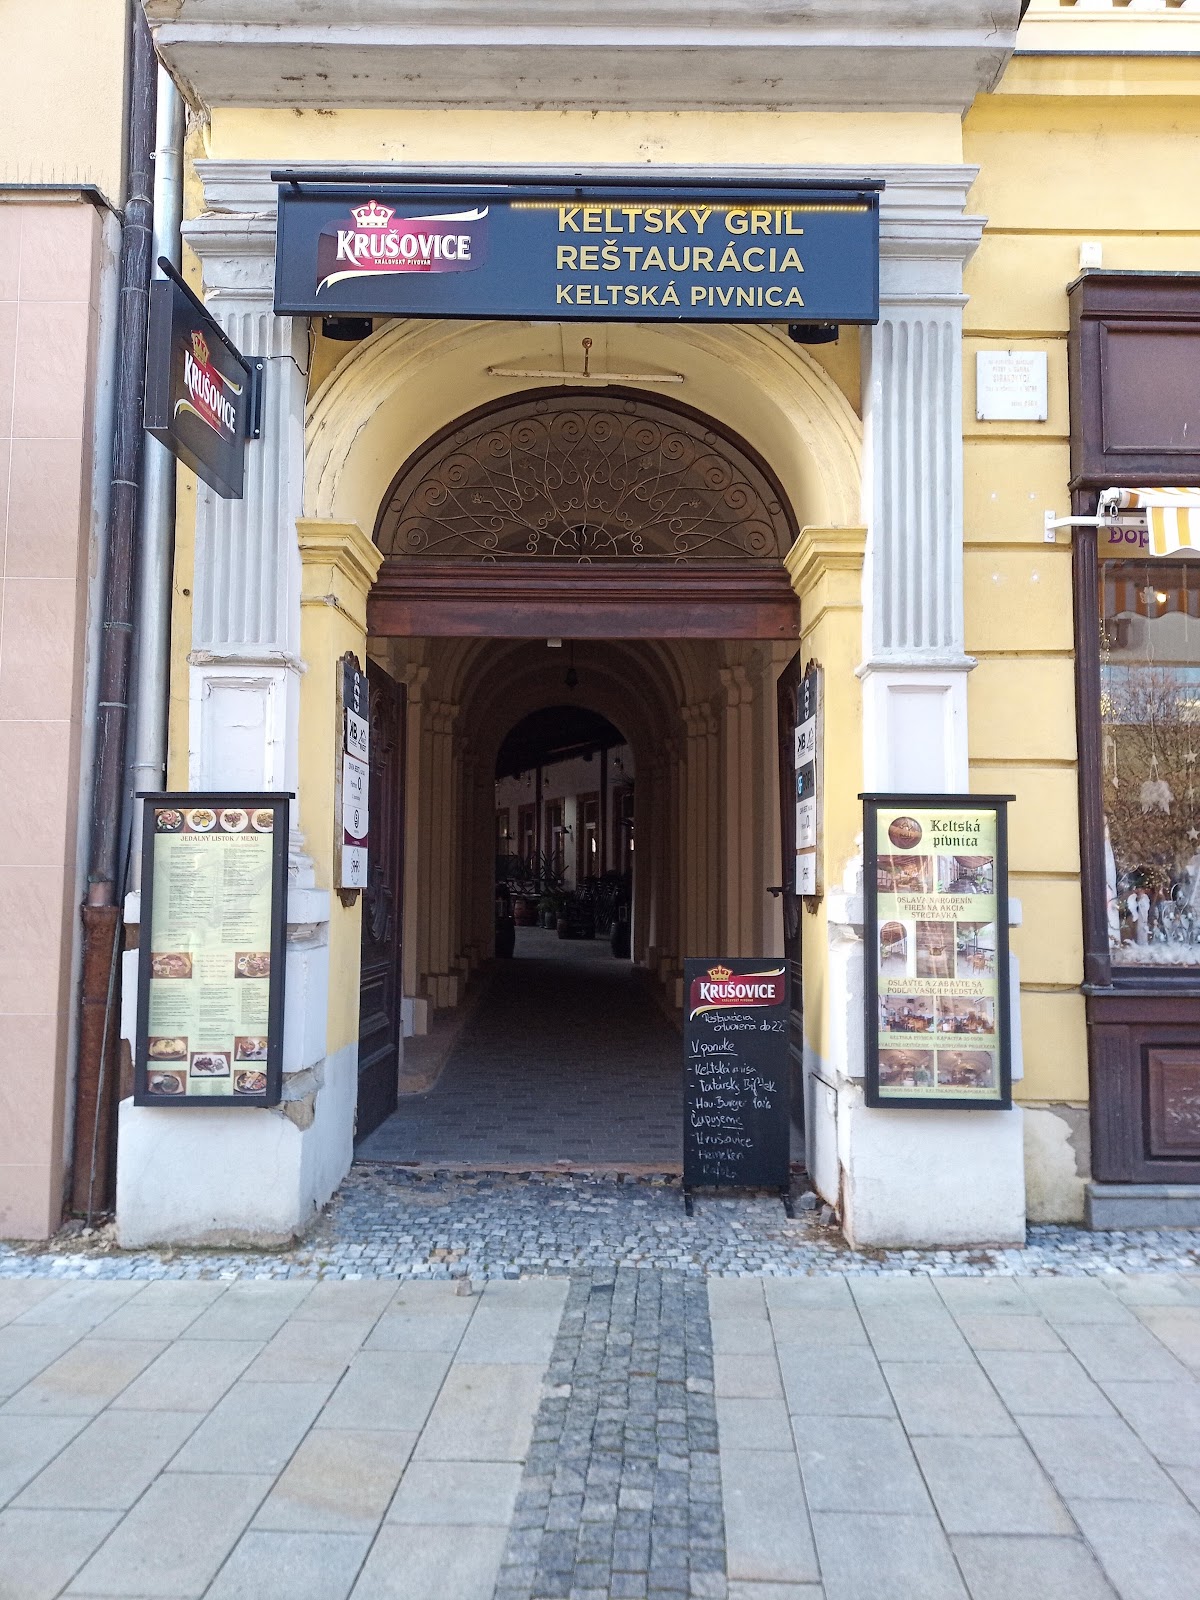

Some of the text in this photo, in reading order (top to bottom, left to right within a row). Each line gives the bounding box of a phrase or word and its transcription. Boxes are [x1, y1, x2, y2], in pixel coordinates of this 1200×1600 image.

[558, 204, 804, 235] KELTSKÝ GRIL
[335, 229, 472, 267] KRUŠOVICE
[556, 239, 805, 272] REŠTAURÁCIA
[556, 280, 805, 307] KELTSKÁ PIVNICA
[184, 350, 236, 434] KRUŠOVICE
[930, 818, 981, 832] Keltská
[933, 834, 978, 848] pivnica
[699, 981, 776, 1004] KRUŠOVICE
[759, 1019, 771, 1032] do
